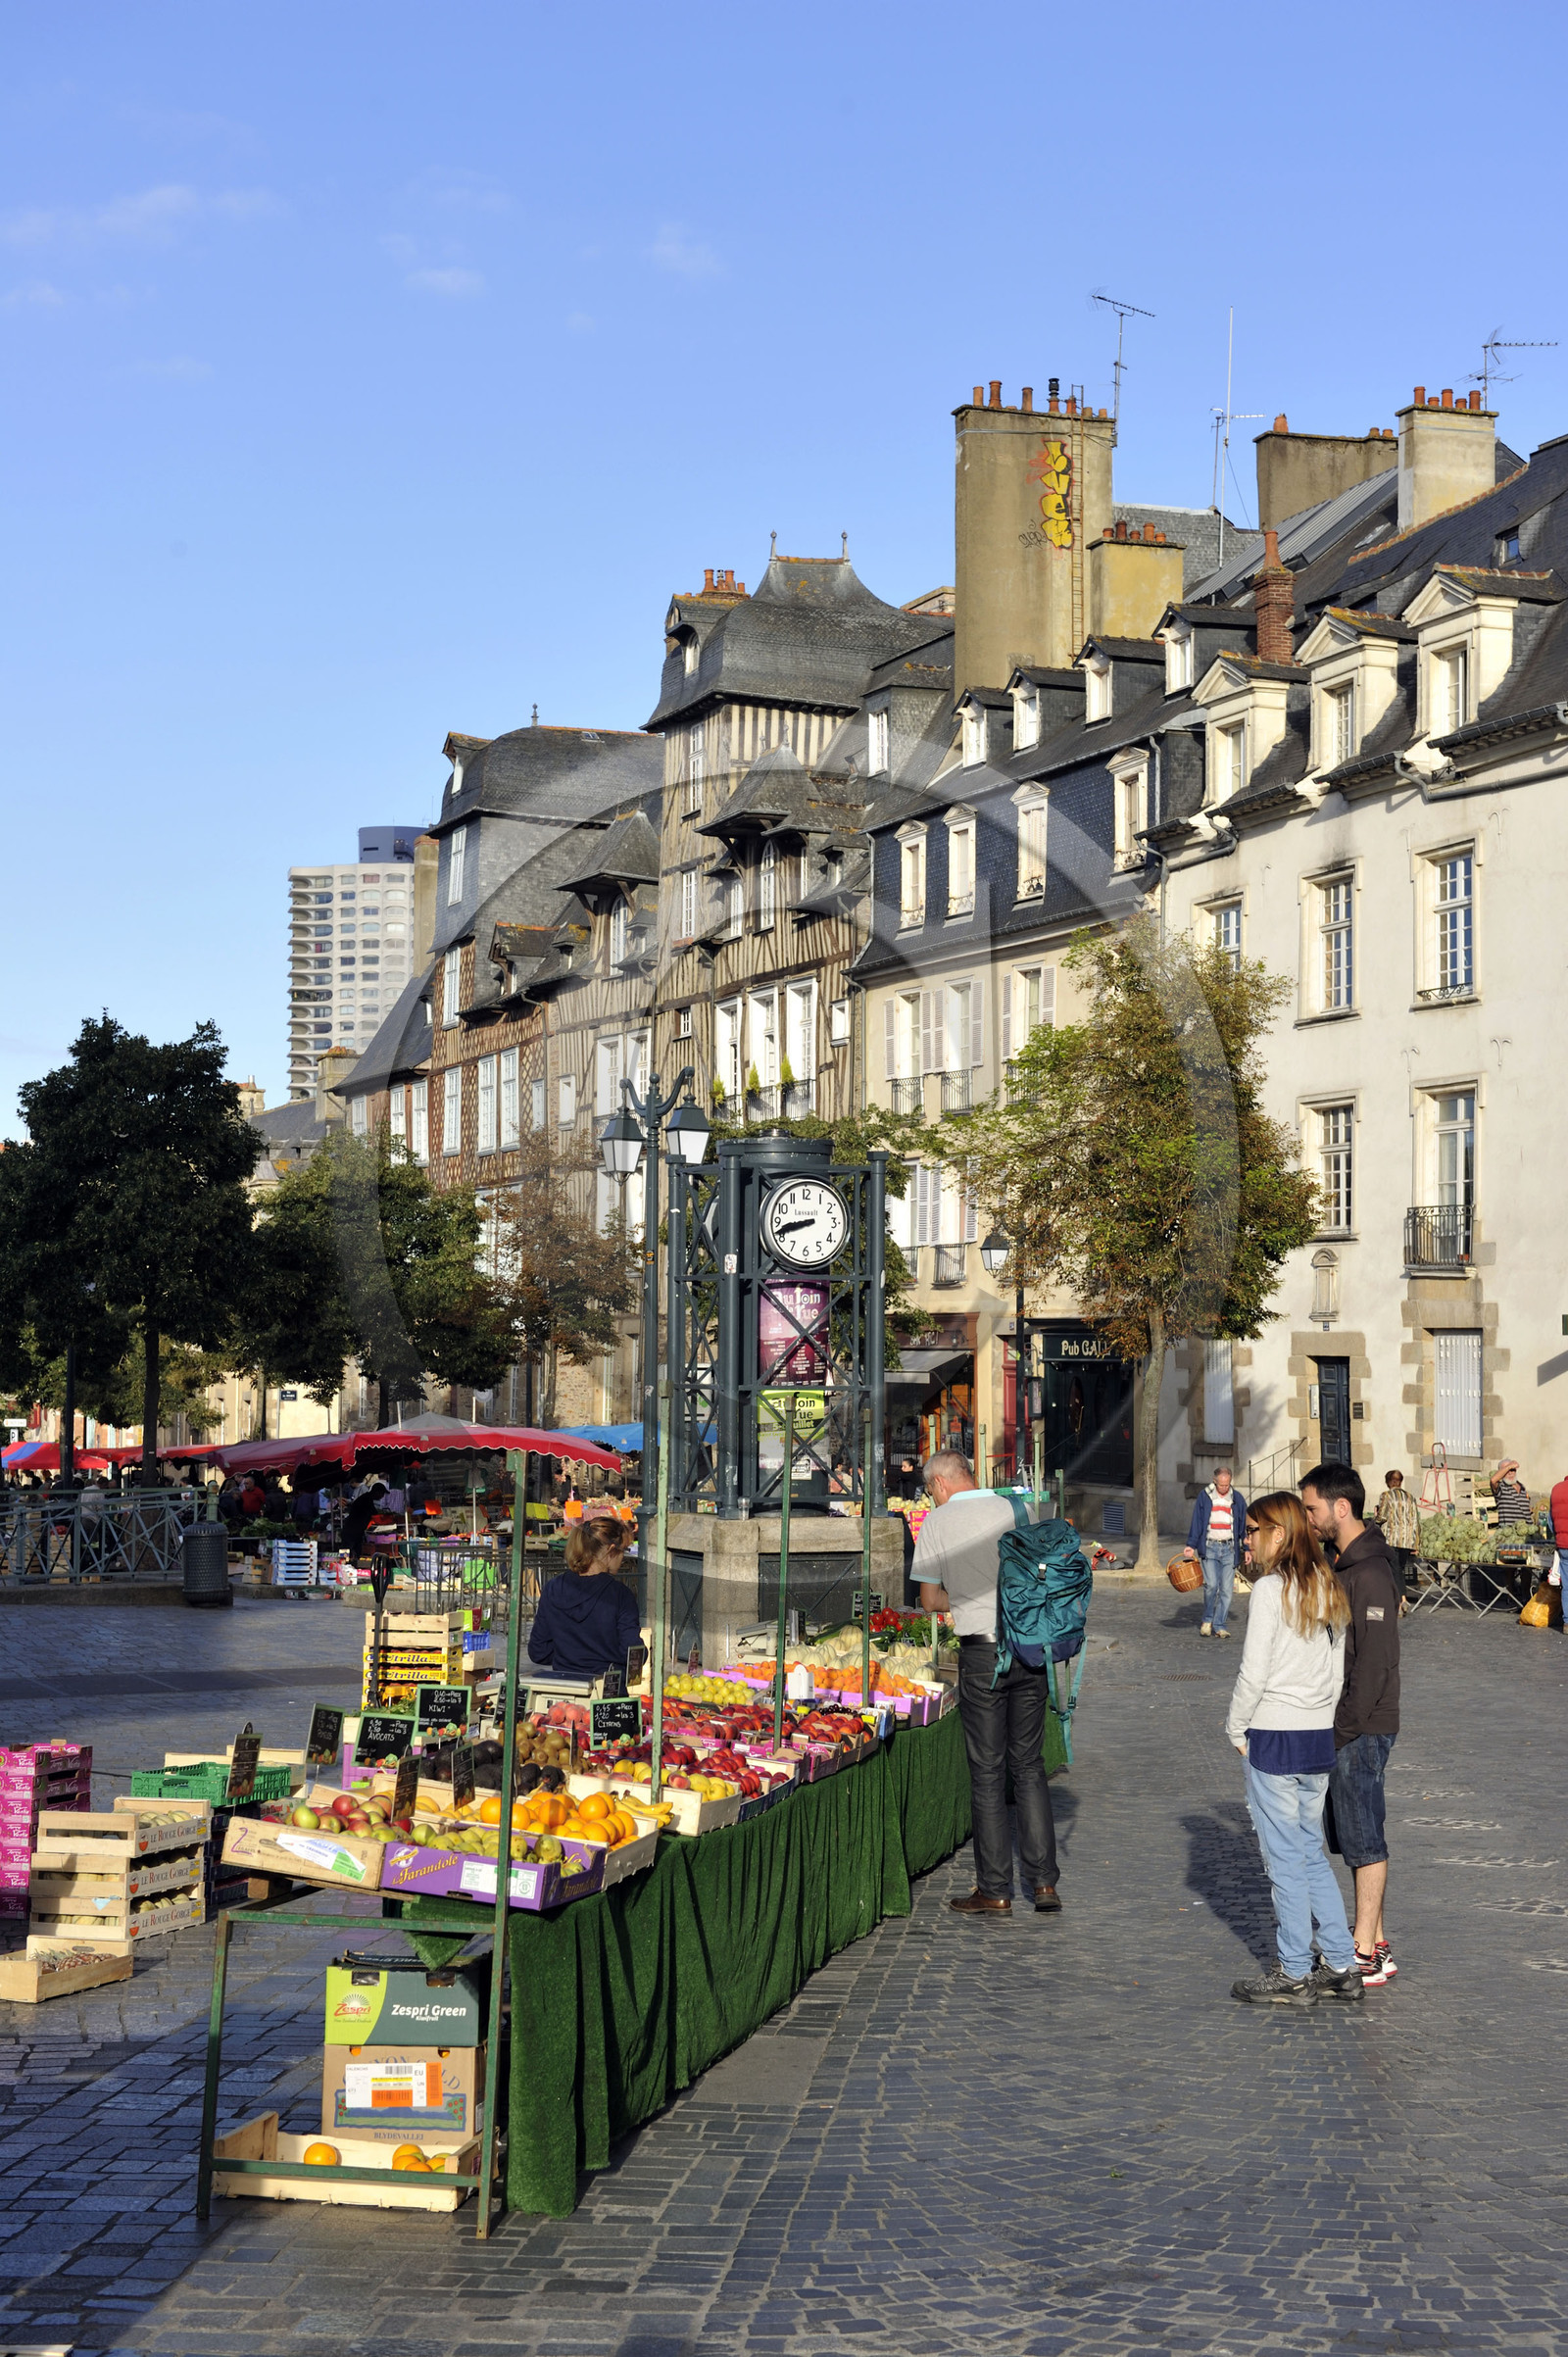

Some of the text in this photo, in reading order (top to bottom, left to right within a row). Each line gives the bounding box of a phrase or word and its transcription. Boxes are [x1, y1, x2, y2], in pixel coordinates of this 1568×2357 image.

[790, 1193, 795, 1204] 11
[803, 1188, 811, 1200] 12
[778, 1203, 788, 1214] 10
[827, 1203, 833, 1213] 2
[774, 1217, 781, 1227] 9
[831, 1217, 837, 1229] 3
[779, 1233, 785, 1242] 8
[826, 1232, 832, 1243] 4
[790, 1241, 796, 1252] 7
[803, 1246, 809, 1257] 6
[816, 1241, 822, 1252] 5
[1061, 1340, 1079, 1356] Pub
[368, 1732, 395, 1741] AVOCATS
[150, 1824, 196, 1843] LE ROUGE GORGE
[399, 1853, 458, 1884] Farandole
[141, 1867, 189, 1885] LE ROUGE GORGE
[142, 1909, 190, 1928] LE ROUGE GORGE
[334, 2003, 371, 2017] Zespri
[392, 2004, 466, 2018] Zespri Green
